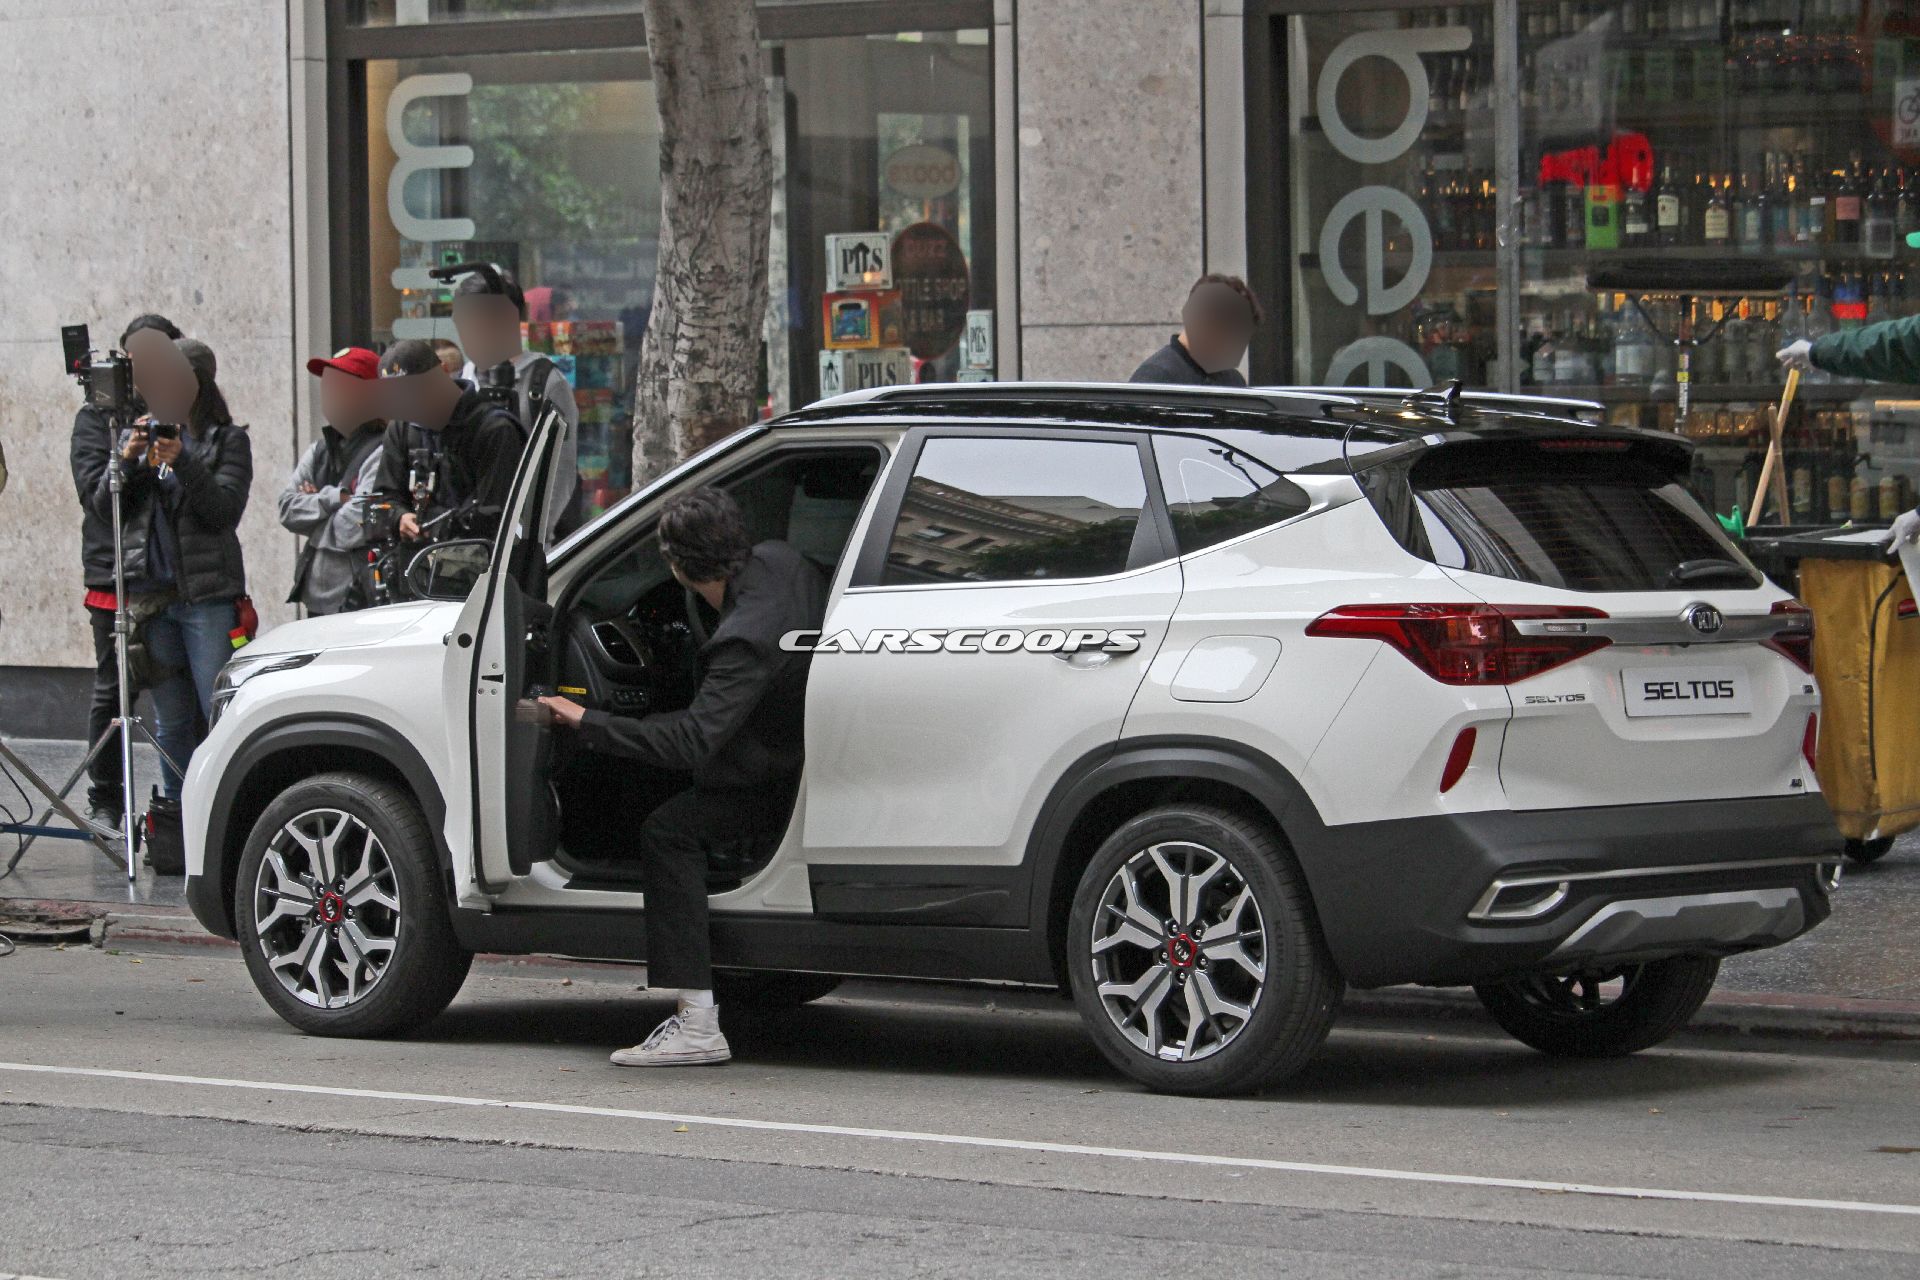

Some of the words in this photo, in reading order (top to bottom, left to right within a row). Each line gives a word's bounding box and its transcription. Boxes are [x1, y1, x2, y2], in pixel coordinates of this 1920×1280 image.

[842, 248, 883, 274] PILS
[858, 362, 897, 388] PILS
[1696, 611, 1721, 629] KIA
[1524, 693, 1586, 704] SELTOS
[1644, 680, 1734, 701] SELTOS
